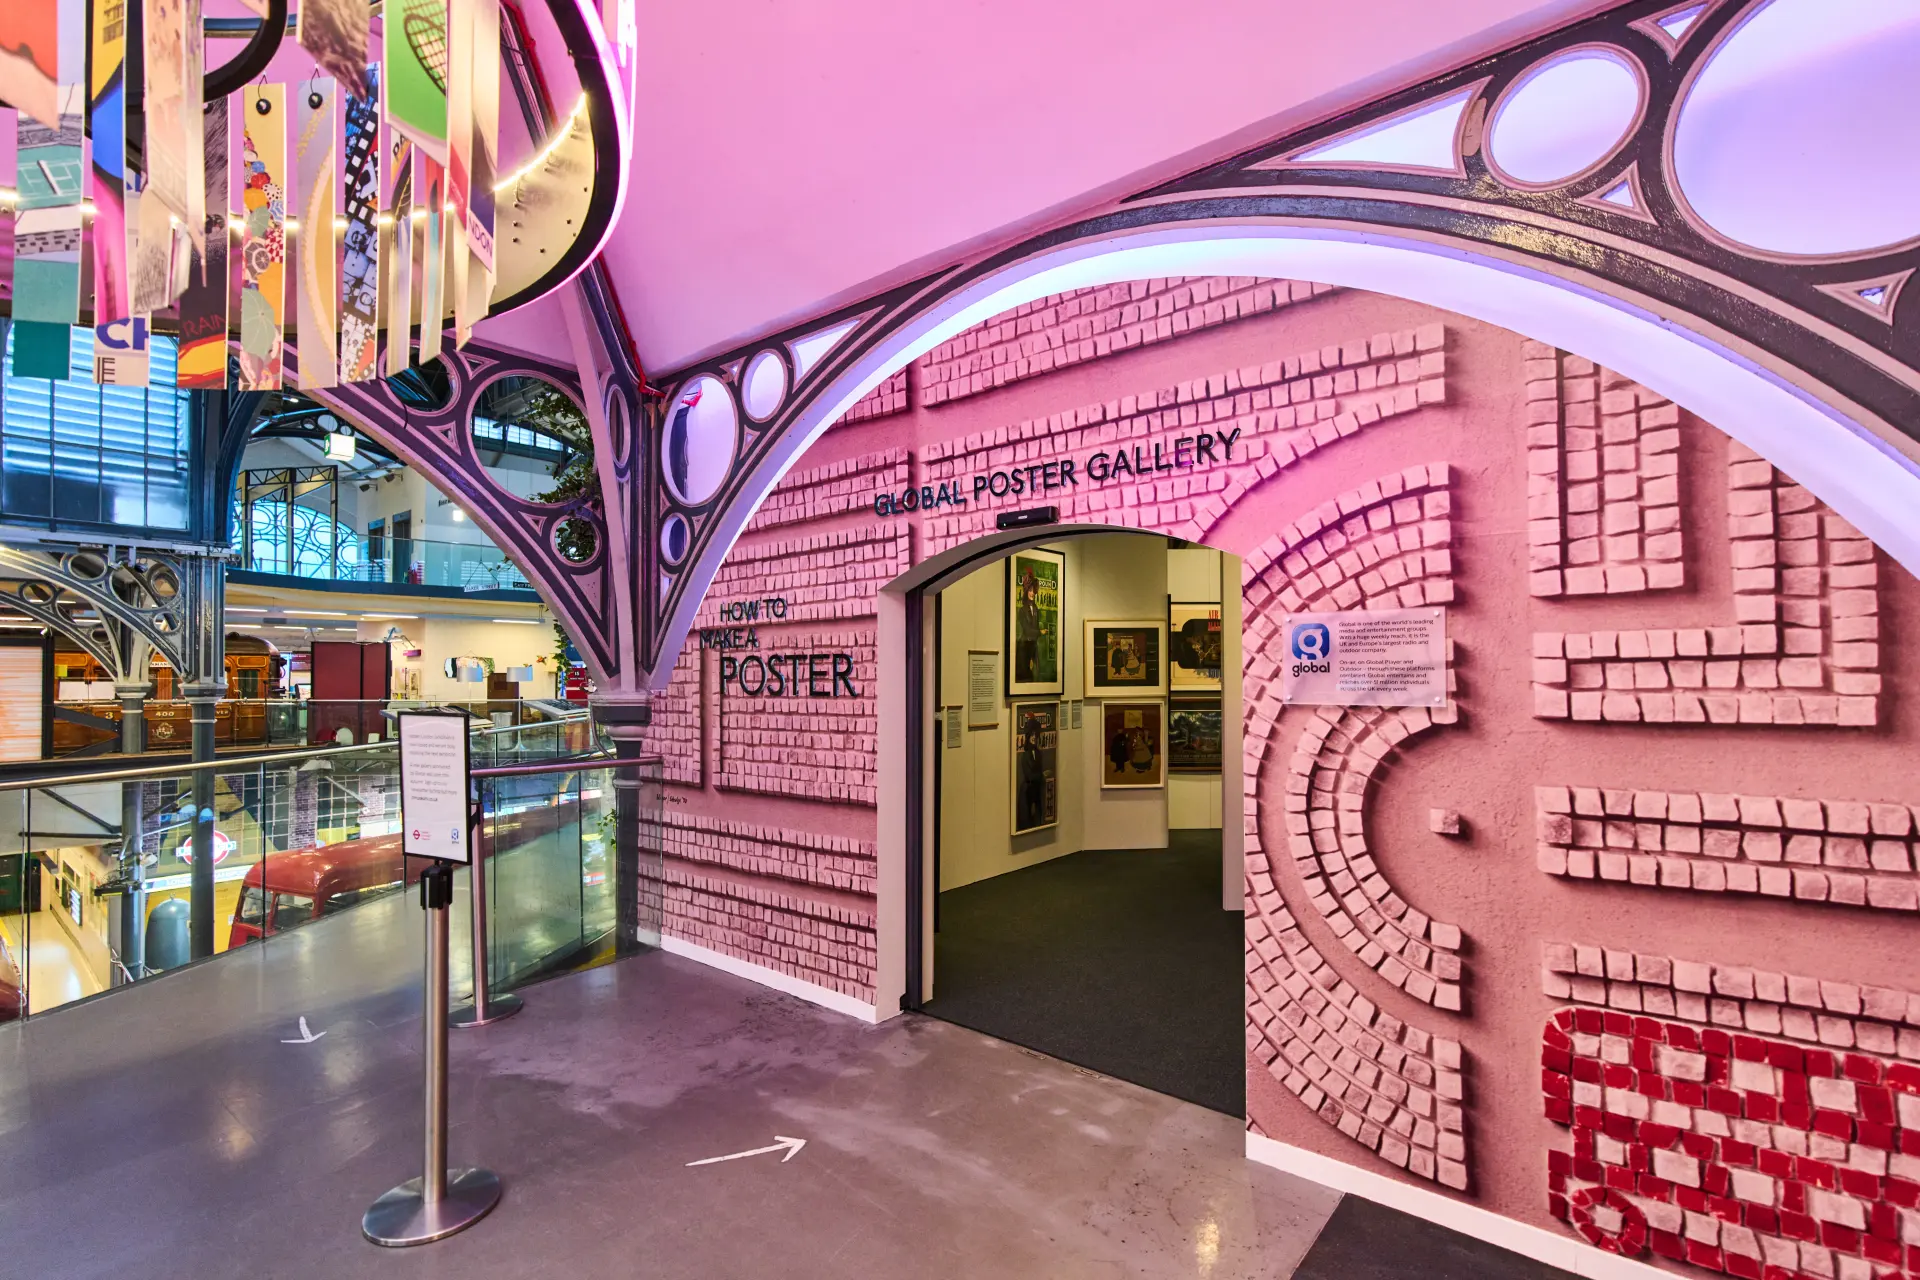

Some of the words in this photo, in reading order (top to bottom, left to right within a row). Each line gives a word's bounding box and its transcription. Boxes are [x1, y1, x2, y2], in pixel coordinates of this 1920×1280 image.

[874, 481, 966, 516] GLOBAL
[974, 460, 1079, 500] POSTER
[1087, 428, 1241, 481] GALLERY
[720, 599, 760, 622] HOW
[763, 597, 787, 618] TO
[699, 628, 744, 649] MAKE
[745, 627, 759, 648] A
[720, 653, 857, 697] POSTER
[1292, 662, 1330, 678] global
